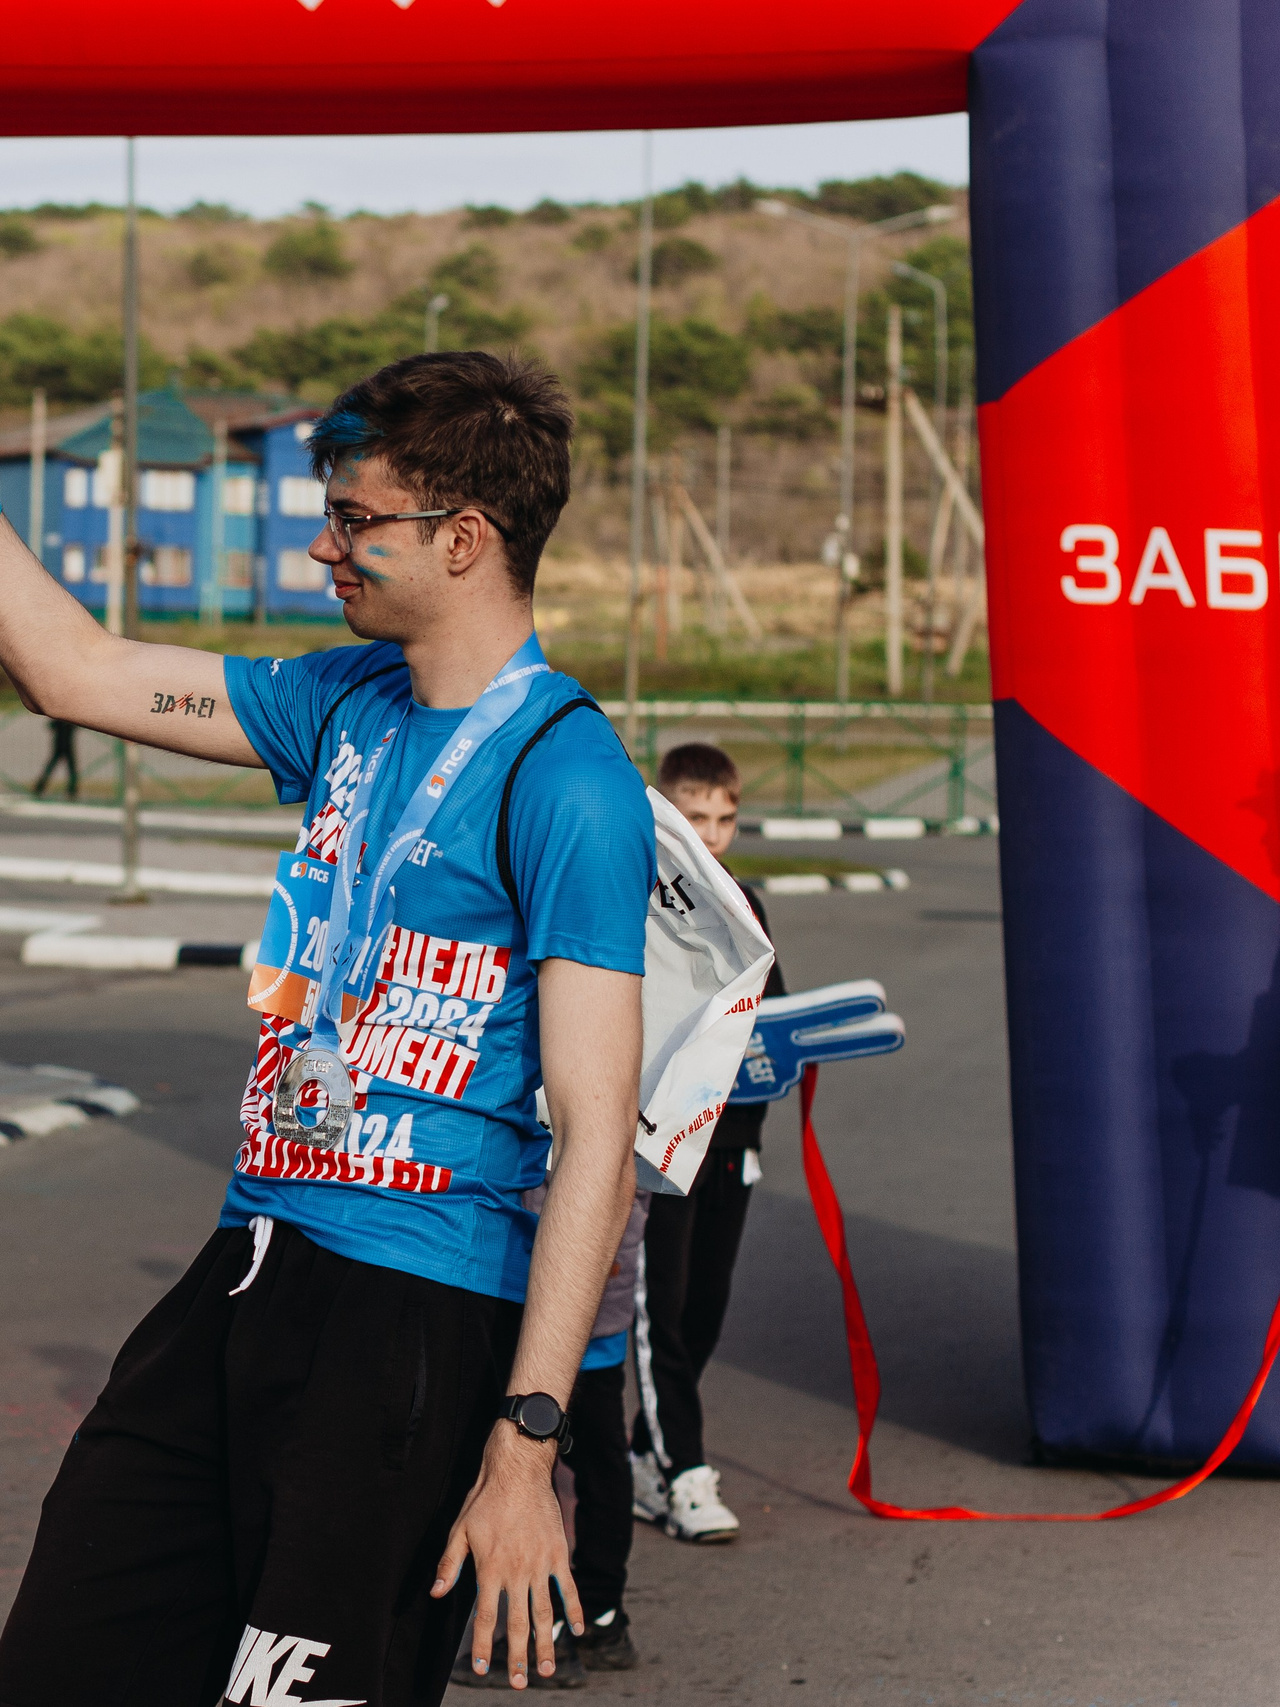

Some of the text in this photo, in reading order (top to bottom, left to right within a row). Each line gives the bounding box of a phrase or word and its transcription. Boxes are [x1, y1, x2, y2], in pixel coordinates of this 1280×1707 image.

[1059, 523, 1280, 611] ЗАБ
[442, 737, 473, 775] ПСБ
[308, 866, 329, 883] ПСБ
[406, 838, 437, 868] ЕГ
[724, 998, 754, 1016] ОДА
[342, 1024, 481, 1101] ОМЕНТ
[334, 1113, 413, 1161] 024
[660, 1107, 714, 1173] МОМЕНТ #ЦЕЛЬ
[225, 1624, 331, 1707] IKE
